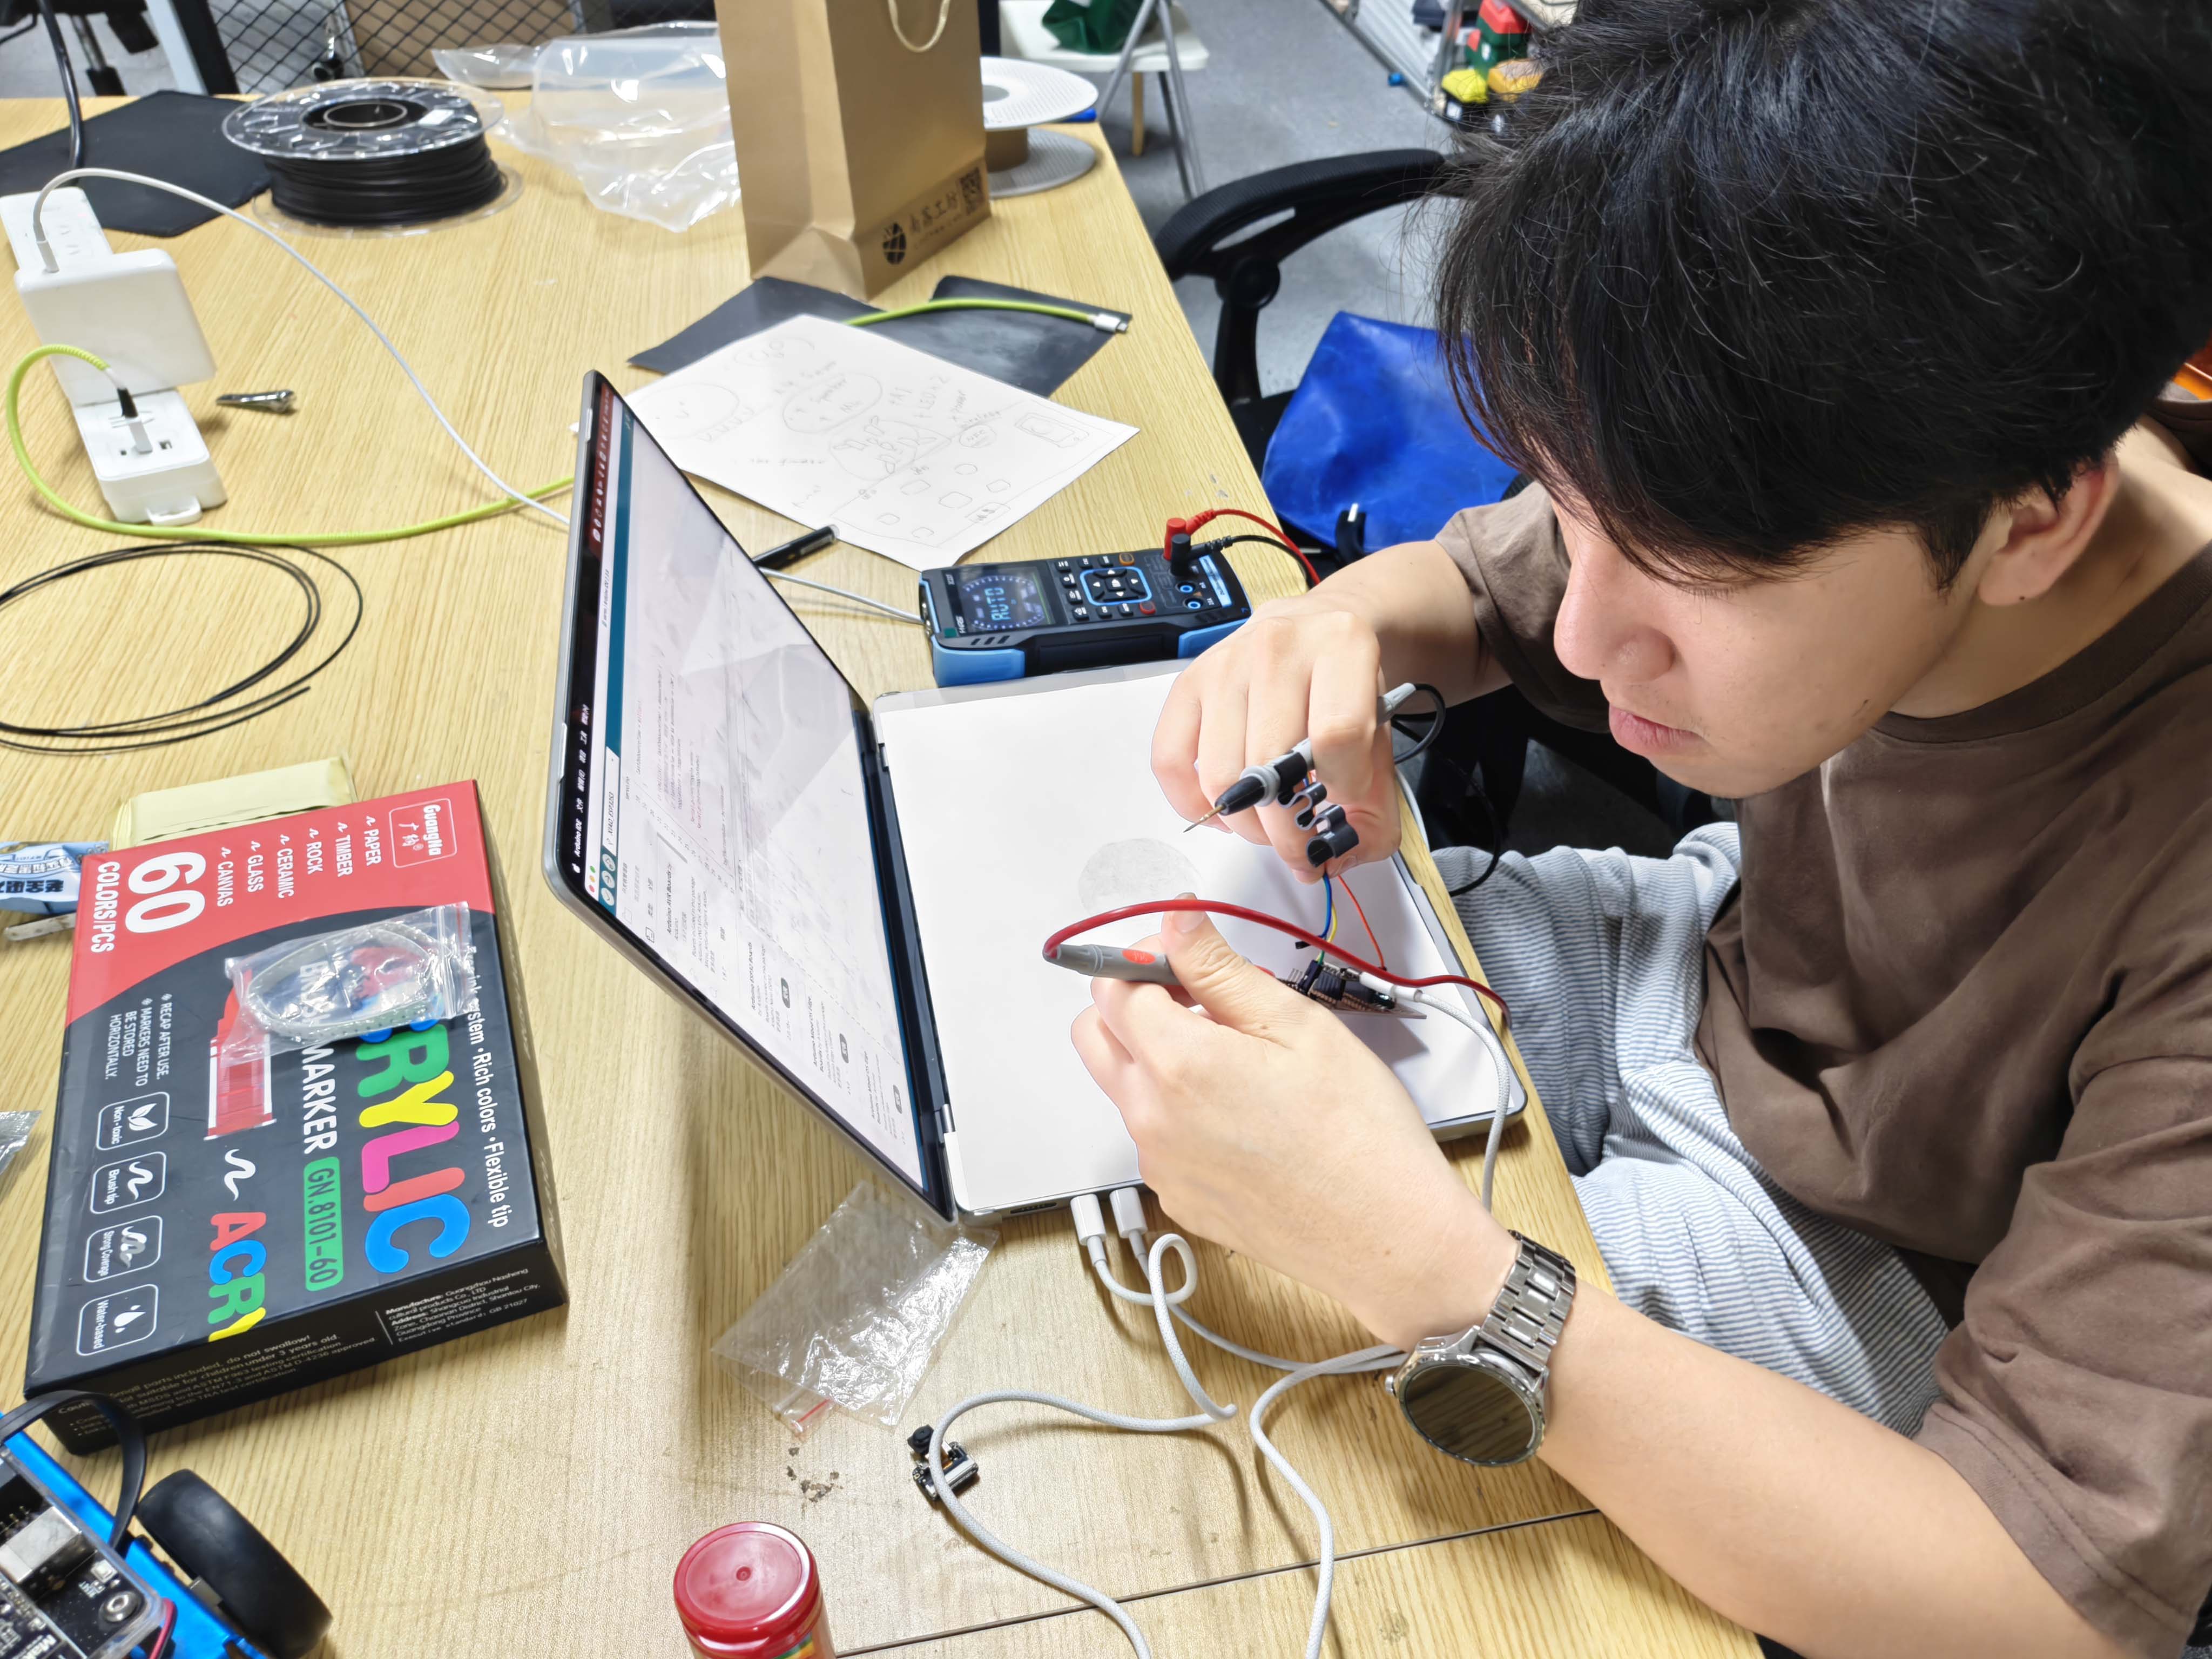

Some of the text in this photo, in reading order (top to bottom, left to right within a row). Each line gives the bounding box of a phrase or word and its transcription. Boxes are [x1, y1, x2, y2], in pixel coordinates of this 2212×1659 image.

[984, 586, 1011, 621] AUTO
[364, 828, 381, 866] PAPER
[423, 804, 443, 856] GuangNa
[574, 828, 582, 858] Arduino
[247, 854, 264, 893] GLASS
[276, 847, 294, 899] CERAMIC
[306, 840, 323, 875] ROCK
[335, 834, 353, 877] TIMBER
[90, 861, 120, 953] COLORS/PCS
[125, 852, 206, 934] 60
[217, 861, 234, 907] CANVAS
[123, 1010, 137, 1057] BE STORED
[157, 1002, 172, 1080] RECAP AFTER USE.
[467, 999, 485, 1045] stem
[105, 1014, 122, 1080] HORIZONTALLY.
[135, 1007, 152, 1087] MARKERS NEED TO
[473, 1051, 494, 1085] Rich
[302, 1042, 338, 1154] MARKER
[476, 1088, 496, 1134] colors
[104, 1168, 120, 1205] Brush tip
[484, 1142, 510, 1203] Flexible
[307, 1167, 339, 1283] GN.8101-60
[488, 1209, 512, 1228] tip
[97, 1230, 114, 1277] Strong Coverage
[386, 1268, 529, 1315] Manufacture: Guangzhou Nasheng
[419, 1298, 453, 1315] products
[471, 1286, 487, 1295] LTD
[473, 1285, 510, 1301] Industrial
[489, 1306, 503, 1314] GB
[504, 1298, 528, 1310] 21027
[93, 1299, 109, 1350] Water-based
[396, 1307, 482, 1337] Guangdong Province
[227, 1356, 241, 1365] do
[244, 1350, 261, 1359] not
[264, 1334, 311, 1353] swallow!
[245, 1353, 276, 1366] under
[288, 1340, 319, 1354] years
